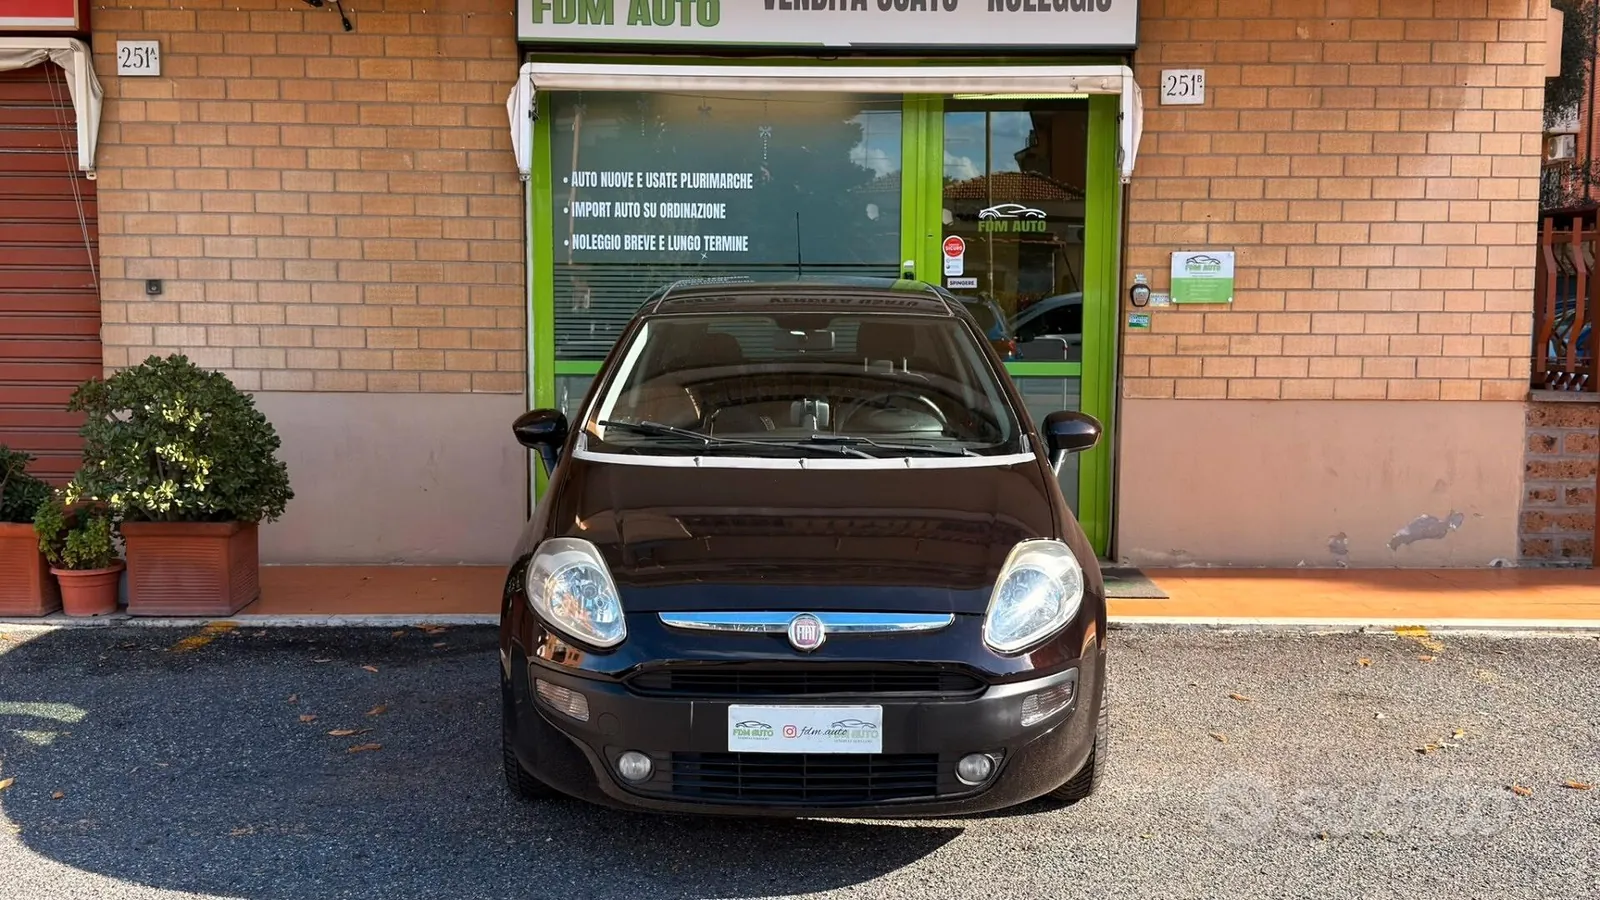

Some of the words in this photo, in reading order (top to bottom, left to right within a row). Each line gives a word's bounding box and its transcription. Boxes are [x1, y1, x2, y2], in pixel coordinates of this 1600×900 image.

[532, 0, 614, 25] FDM
[627, 0, 720, 27] AUTO
[571, 171, 598, 188] AUTO
[600, 172, 634, 188] NUOVE
[637, 173, 643, 188] E
[646, 173, 678, 188] USATE
[680, 173, 753, 189] PLURIMARCHE
[571, 202, 611, 217] IMPORT
[614, 202, 640, 218] AUTO
[643, 203, 657, 218] SU
[660, 203, 726, 219] ORDINAZIONE
[978, 220, 1008, 232] FDM
[1012, 220, 1047, 232] AUTO
[571, 234, 621, 250] NOLEGGIO
[624, 235, 656, 250] BREVE
[658, 235, 665, 250] E
[668, 235, 701, 251] LUNGO
[703, 236, 748, 251] TERMINE
[797, 625, 816, 640] FIAT
